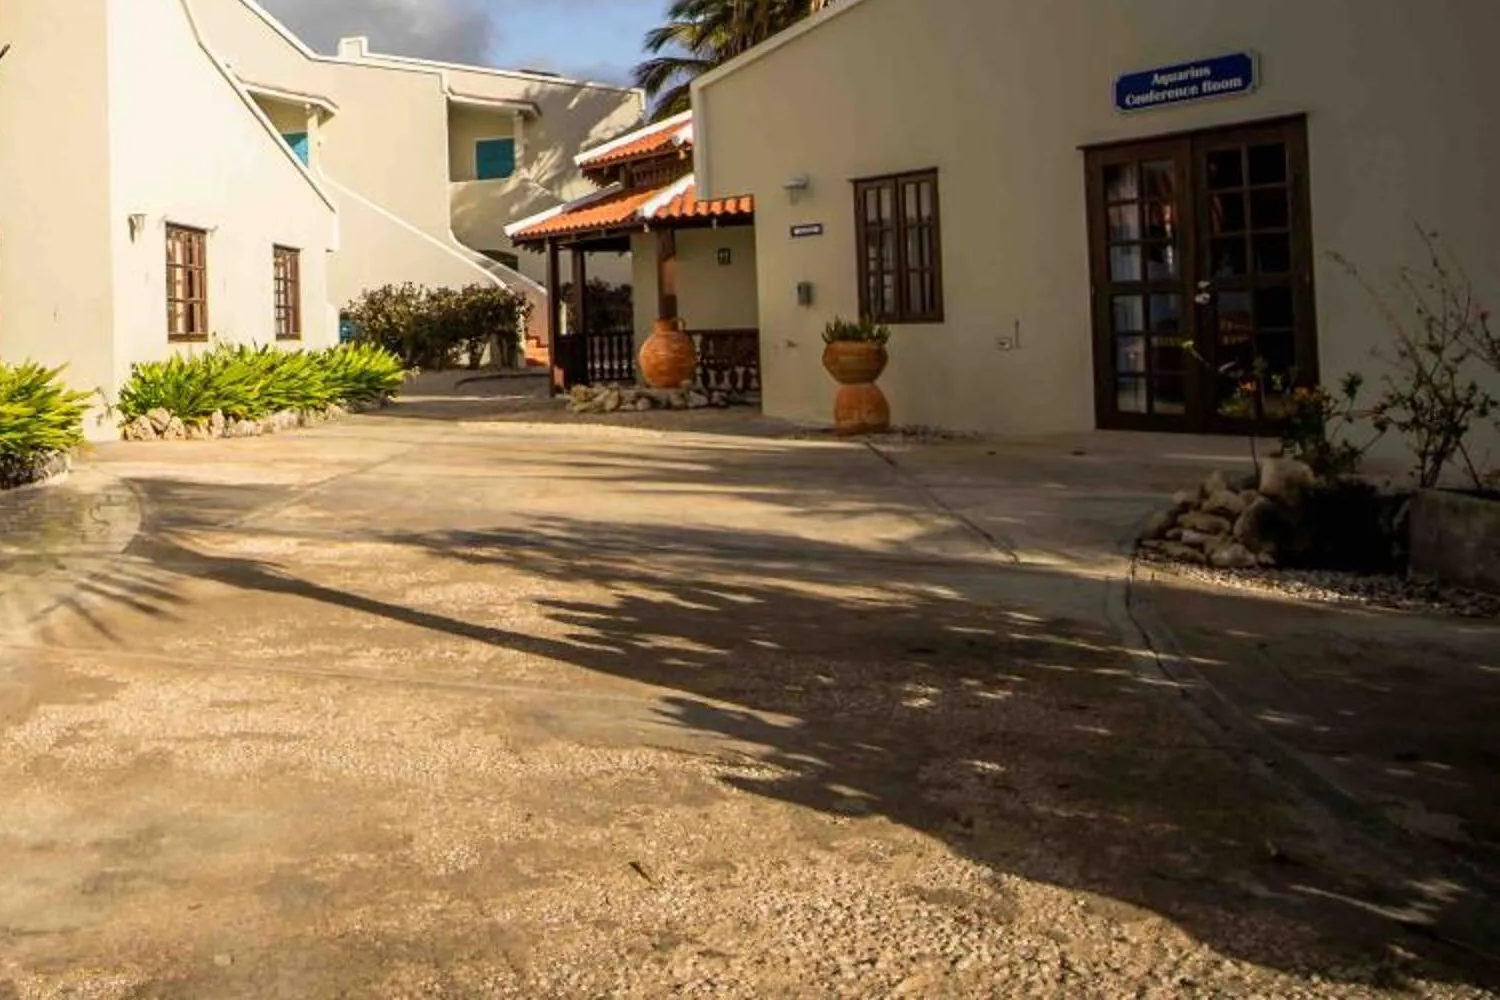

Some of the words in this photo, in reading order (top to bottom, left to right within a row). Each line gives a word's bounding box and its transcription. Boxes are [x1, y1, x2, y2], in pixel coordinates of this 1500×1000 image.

[1151, 65, 1211, 86] Aquarius
[1124, 83, 1199, 106] Conference
[1202, 77, 1243, 93] Room
